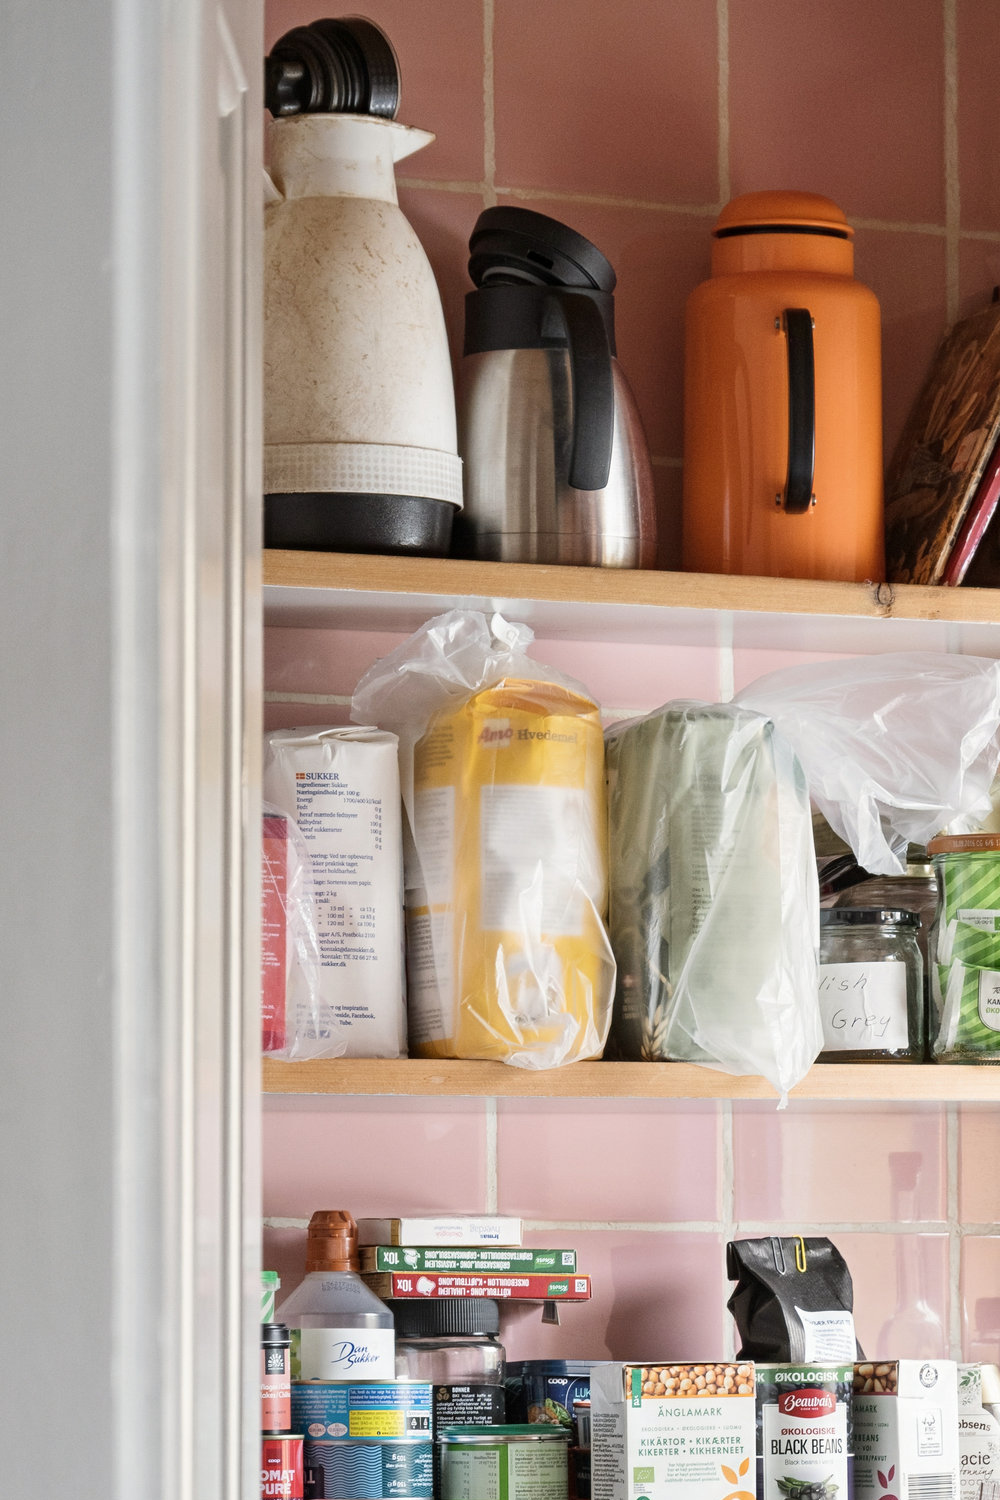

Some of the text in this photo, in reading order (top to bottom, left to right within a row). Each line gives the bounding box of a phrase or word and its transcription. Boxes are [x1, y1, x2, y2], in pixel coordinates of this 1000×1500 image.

[517, 728, 578, 744] Hvedemel
[305, 772, 339, 780] SUKKER
[818, 972, 868, 992] lish
[832, 1008, 891, 1038] Grey
[331, 1341, 368, 1363] Dan
[343, 1353, 381, 1370] Sukker
[548, 1378, 568, 1386] coop
[775, 1371, 838, 1382] ØKOLOGISK
[784, 1394, 832, 1412] Beauvais
[854, 1405, 878, 1413] AMARK
[958, 1419, 991, 1431] obsens
[781, 1427, 836, 1436] ØKOLOGISKE
[640, 1436, 741, 1446] KIKÄRTOR KIKÆRTER
[771, 1438, 843, 1455] BLACK BEANS
[638, 1446, 744, 1457] KIKERTER KIKHERNEET
[961, 1451, 991, 1466] acie
[260, 1469, 296, 1481] OMAT
